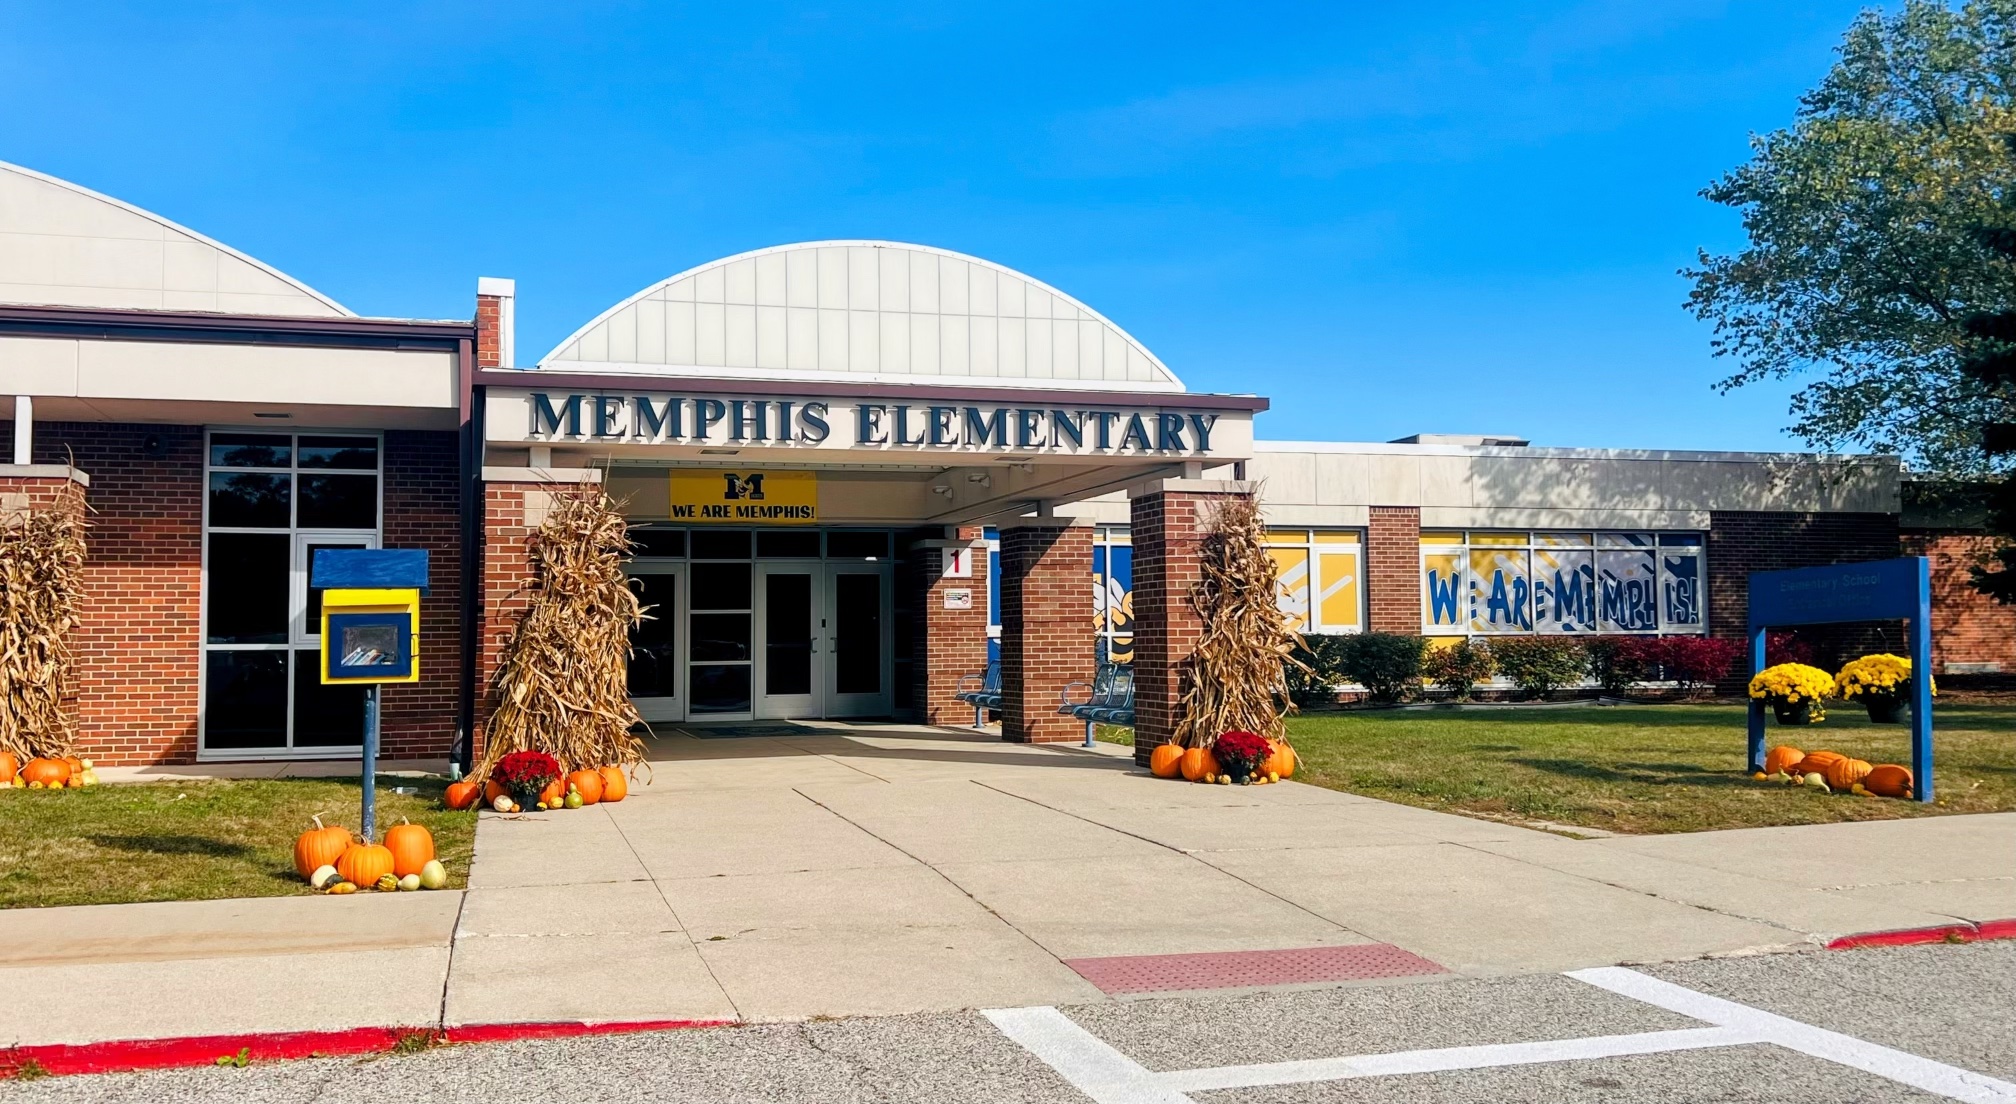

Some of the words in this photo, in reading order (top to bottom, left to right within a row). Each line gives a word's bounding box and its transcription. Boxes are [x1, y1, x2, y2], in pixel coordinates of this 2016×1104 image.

[529, 392, 831, 442] MEMPHIS
[855, 403, 1222, 452] ELEMENTARY
[672, 504, 696, 518] WE
[700, 504, 731, 518] ARE
[735, 505, 815, 519] MEMPHIS!
[950, 549, 960, 574] 1
[1842, 572, 1881, 588] School
[1427, 568, 1478, 625] WE
[1486, 568, 1547, 631] ARE
